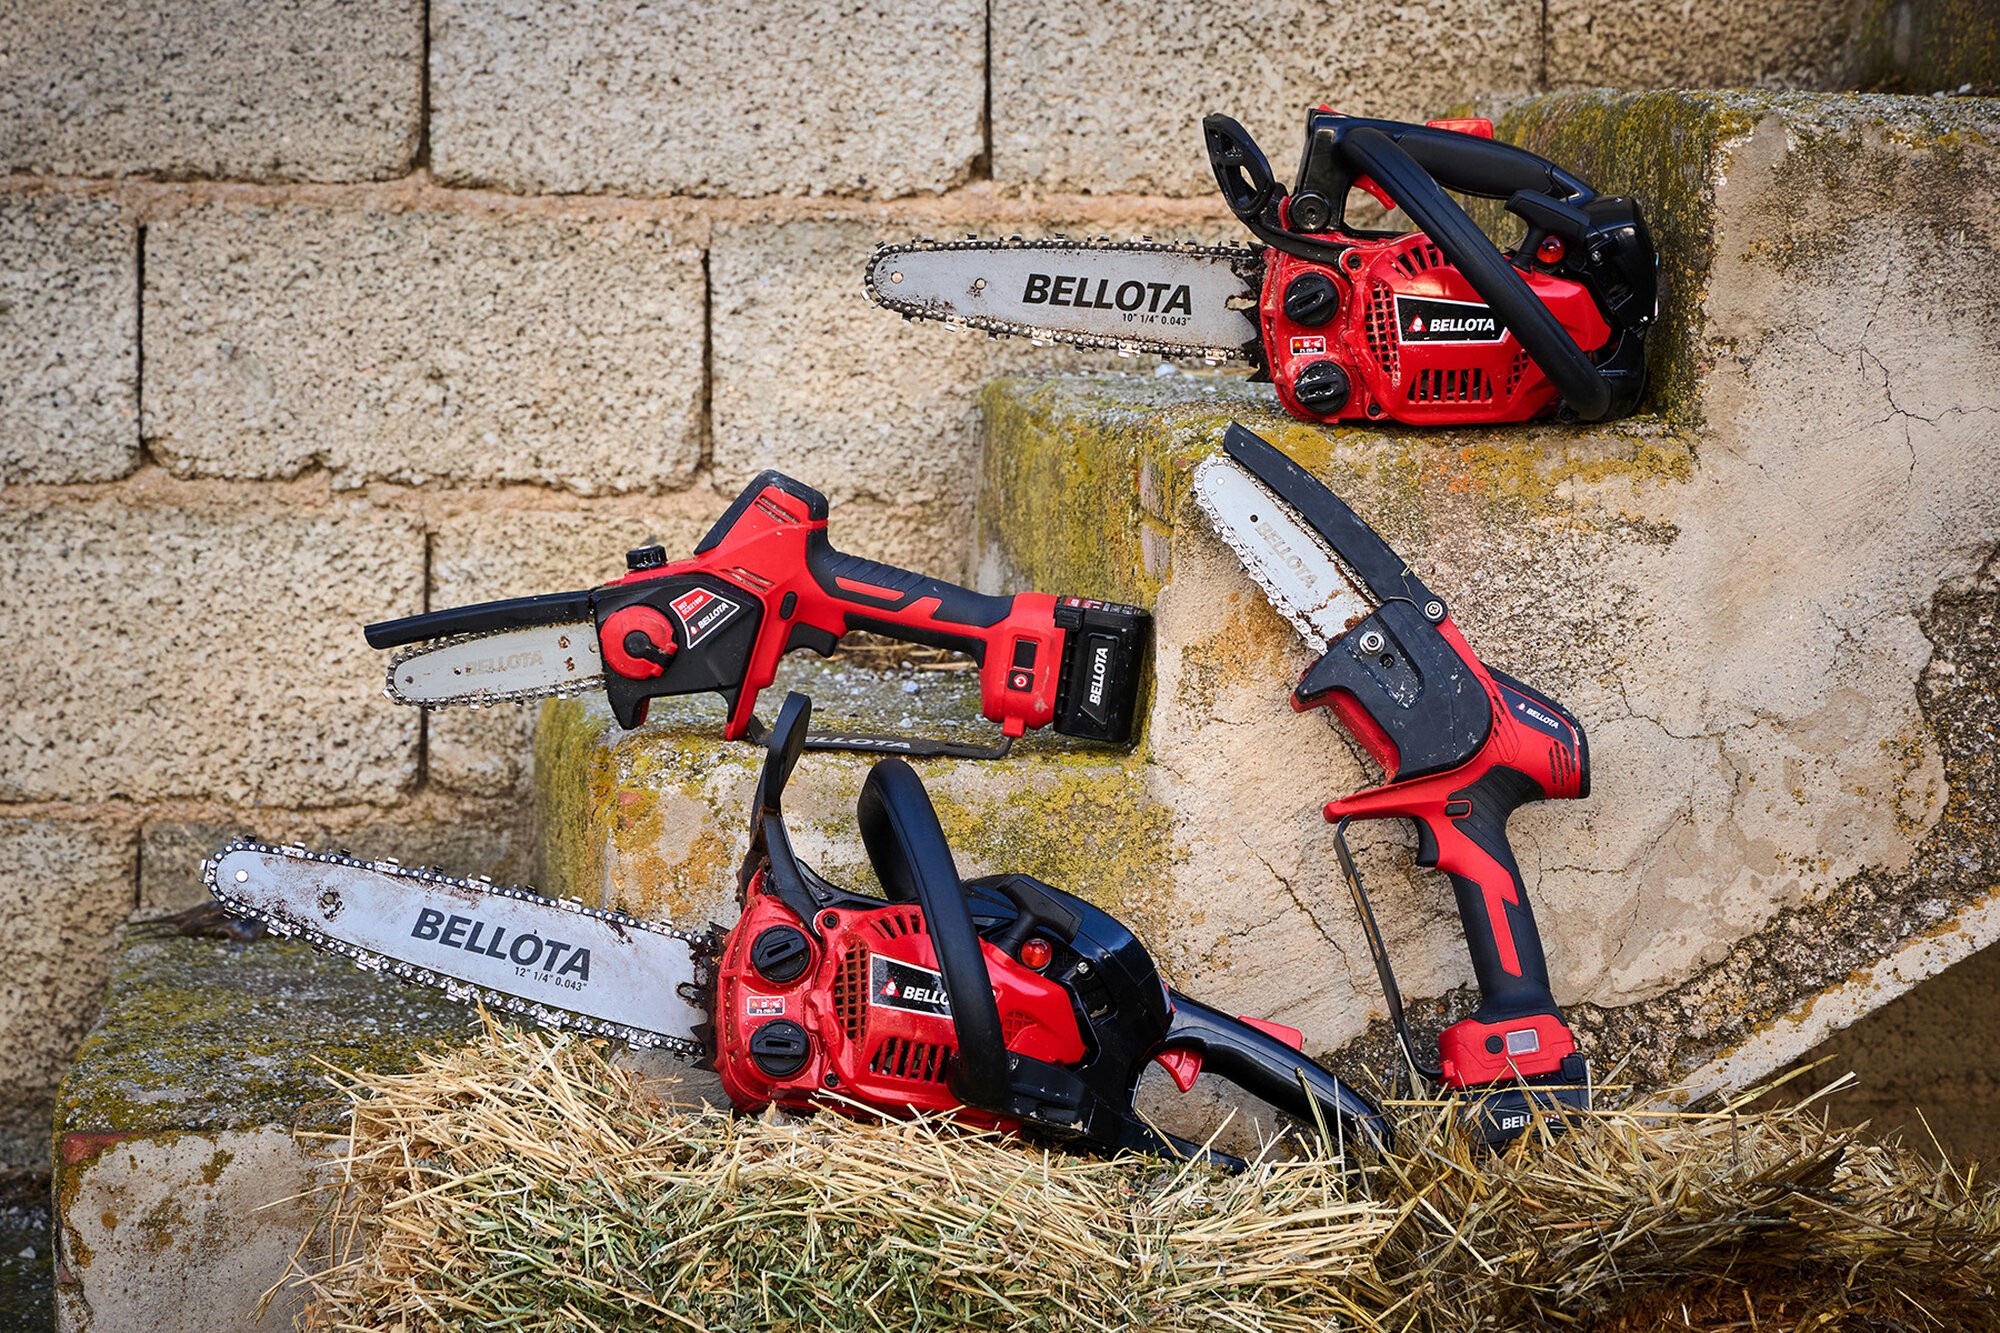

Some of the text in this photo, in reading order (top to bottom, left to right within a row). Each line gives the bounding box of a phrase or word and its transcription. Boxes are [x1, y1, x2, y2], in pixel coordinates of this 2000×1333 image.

[1022, 273, 1192, 315] BELLOTA
[1122, 313, 1192, 326] 10" 1/4" 0.043"
[1429, 318, 1495, 332] BELLOTA
[697, 602, 729, 630] BELLOTA
[1089, 647, 1109, 706] BELLOTA
[1526, 707, 1560, 729] BELLOTA
[805, 736, 911, 749] ELLOTA
[410, 907, 591, 982] BELLOTA
[514, 966, 588, 991] 12" 1/4" 0.043"
[902, 985, 950, 1005] BELLO
